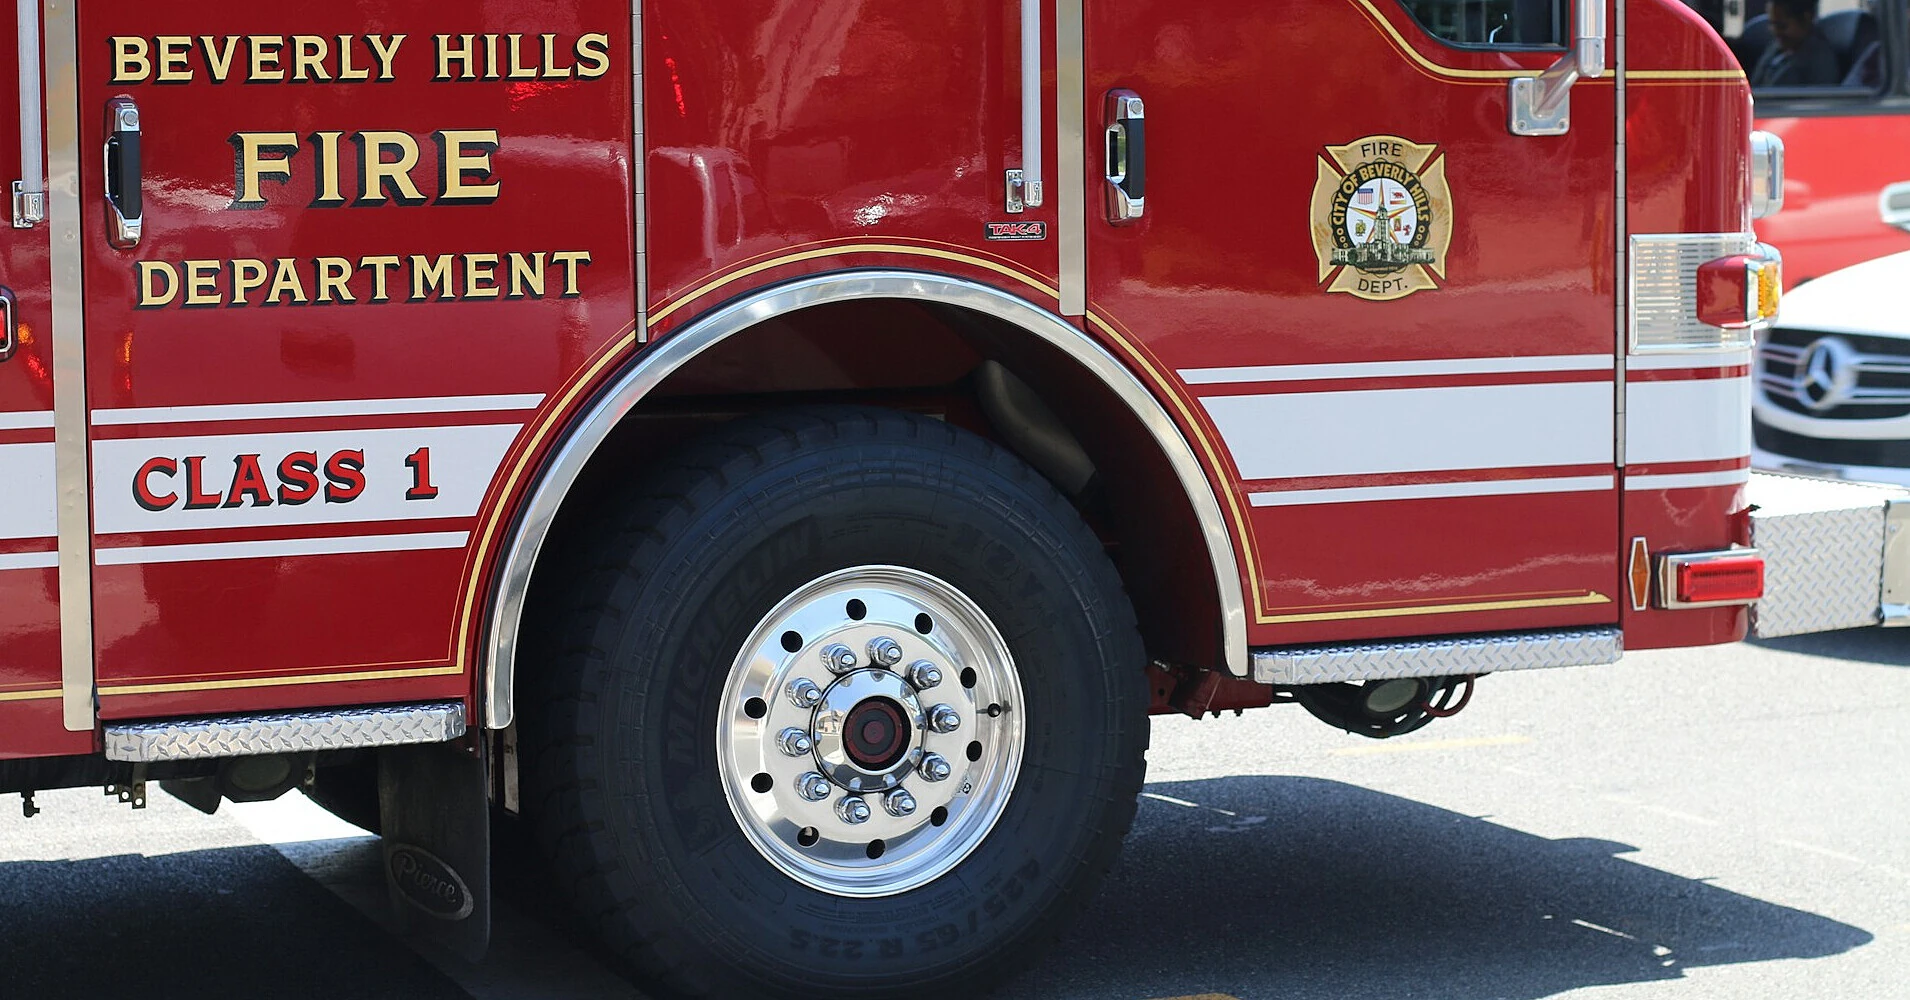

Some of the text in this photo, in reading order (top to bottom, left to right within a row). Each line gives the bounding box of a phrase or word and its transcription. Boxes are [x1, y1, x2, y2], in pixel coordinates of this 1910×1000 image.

[108, 33, 611, 83] BEVERLY HILLS
[230, 128, 502, 209] FIRE
[1361, 141, 1404, 158] FIRE
[1333, 163, 1429, 225] CITY OF BEVERLY HILLS
[135, 250, 592, 308] DEPARTMENT
[1357, 277, 1409, 294] DEPT.
[132, 446, 439, 512] CLASS 1
[394, 851, 457, 903] Pierce
